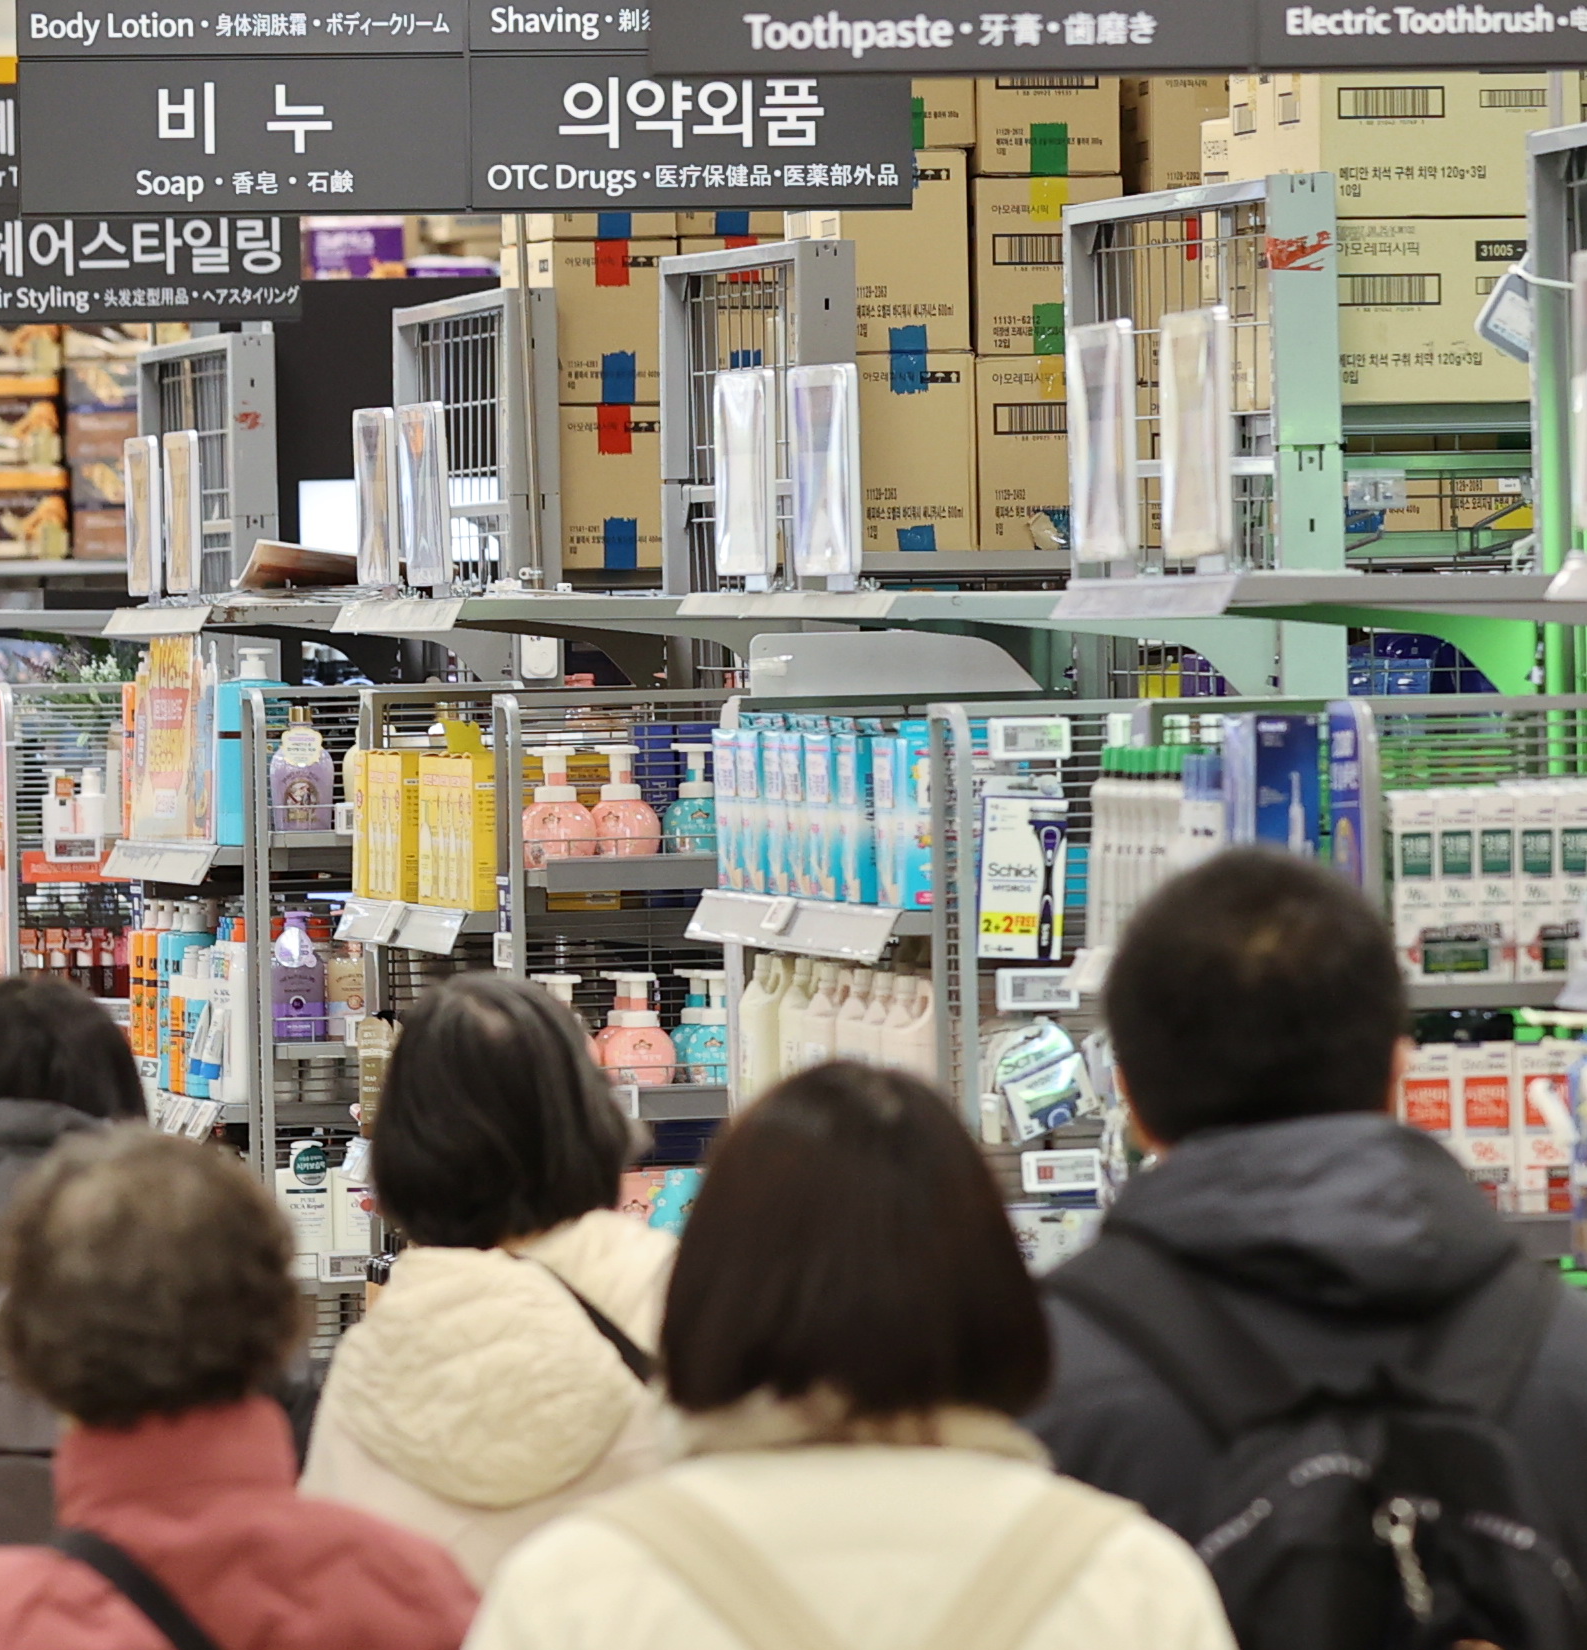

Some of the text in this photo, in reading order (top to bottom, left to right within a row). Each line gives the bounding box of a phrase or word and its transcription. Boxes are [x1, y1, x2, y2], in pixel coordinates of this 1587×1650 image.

[30, 13, 194, 46] Body Lotion
[215, 13, 307, 37] 身体润肤霜
[327, 13, 450, 35] ボディークリーム
[491, 6, 599, 40] Shaving
[979, 14, 1041, 46] 牙膏
[1063, 12, 1157, 46] 歯磨き
[1287, 7, 1554, 36] Electric Toothbrush
[743, 11, 953, 59] Toothpaste
[559, 76, 824, 149] 의약외품
[232, 171, 278, 195] 香皂
[487, 165, 637, 196] OTC Drugs
[656, 165, 771, 187] 医疗保健品
[784, 164, 899, 187] 医薬部外品
[1339, 166, 1368, 181] 메디안
[1372, 166, 1391, 181] 치석
[1394, 166, 1415, 181] 구취
[1418, 165, 1438, 181] 치약
[136, 170, 204, 203] Soap
[1340, 183, 1361, 197] 10입
[16, 287, 89, 313] Styling
[202, 286, 300, 306] ヘアスタイリング
[1369, 353, 1388, 368] 치석
[1391, 353, 1412, 368] 구취
[1415, 352, 1434, 367] 치약
[988, 863, 1037, 878] Schick
